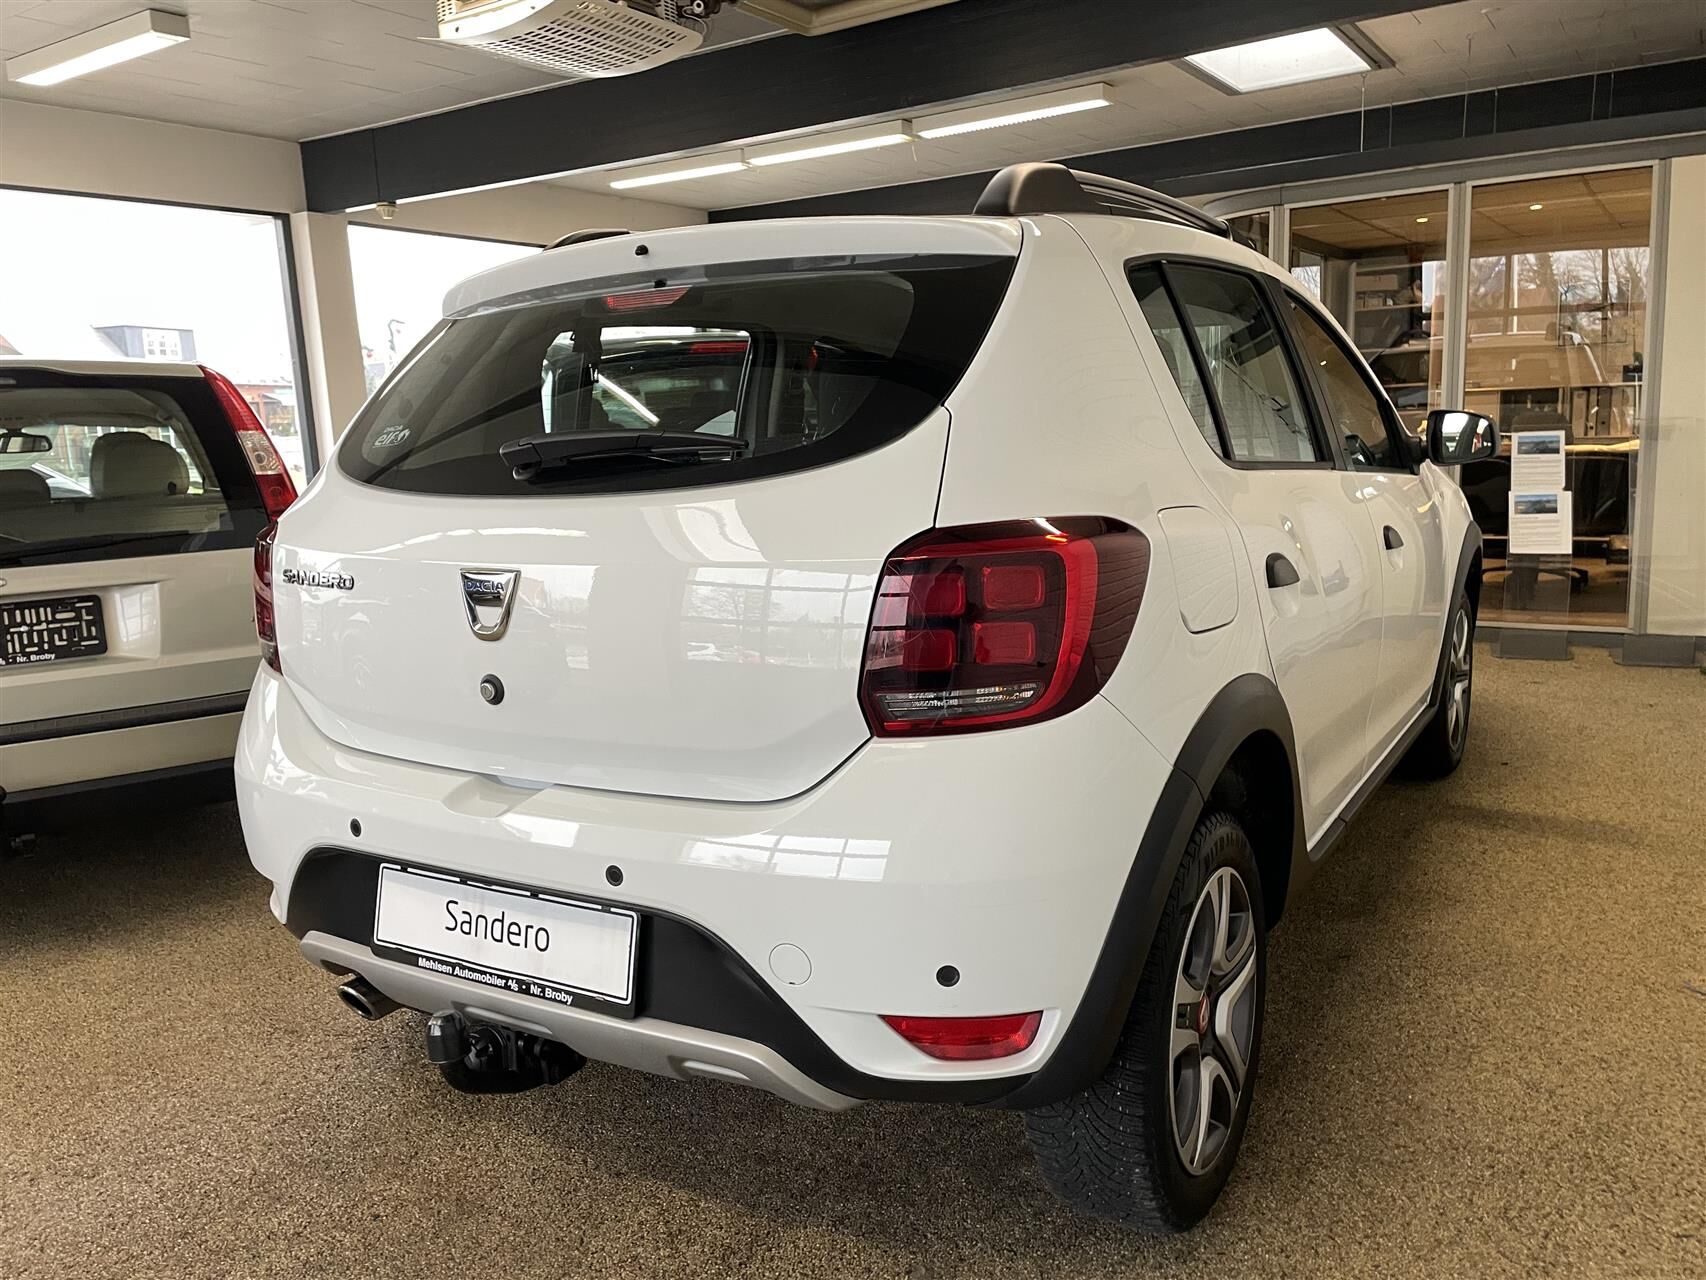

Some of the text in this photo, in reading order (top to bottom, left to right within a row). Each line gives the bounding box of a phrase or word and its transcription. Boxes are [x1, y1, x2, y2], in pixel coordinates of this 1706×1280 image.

[282, 568, 355, 591] SANDERO
[465, 579, 506, 593] DACIA
[30, 653, 55, 662] Broby
[445, 899, 550, 952] Sandero
[418, 957, 452, 974] Mehlsen
[453, 966, 507, 988] Automobiler
[530, 984, 544, 997] Nr.
[545, 987, 573, 1005] Broby
